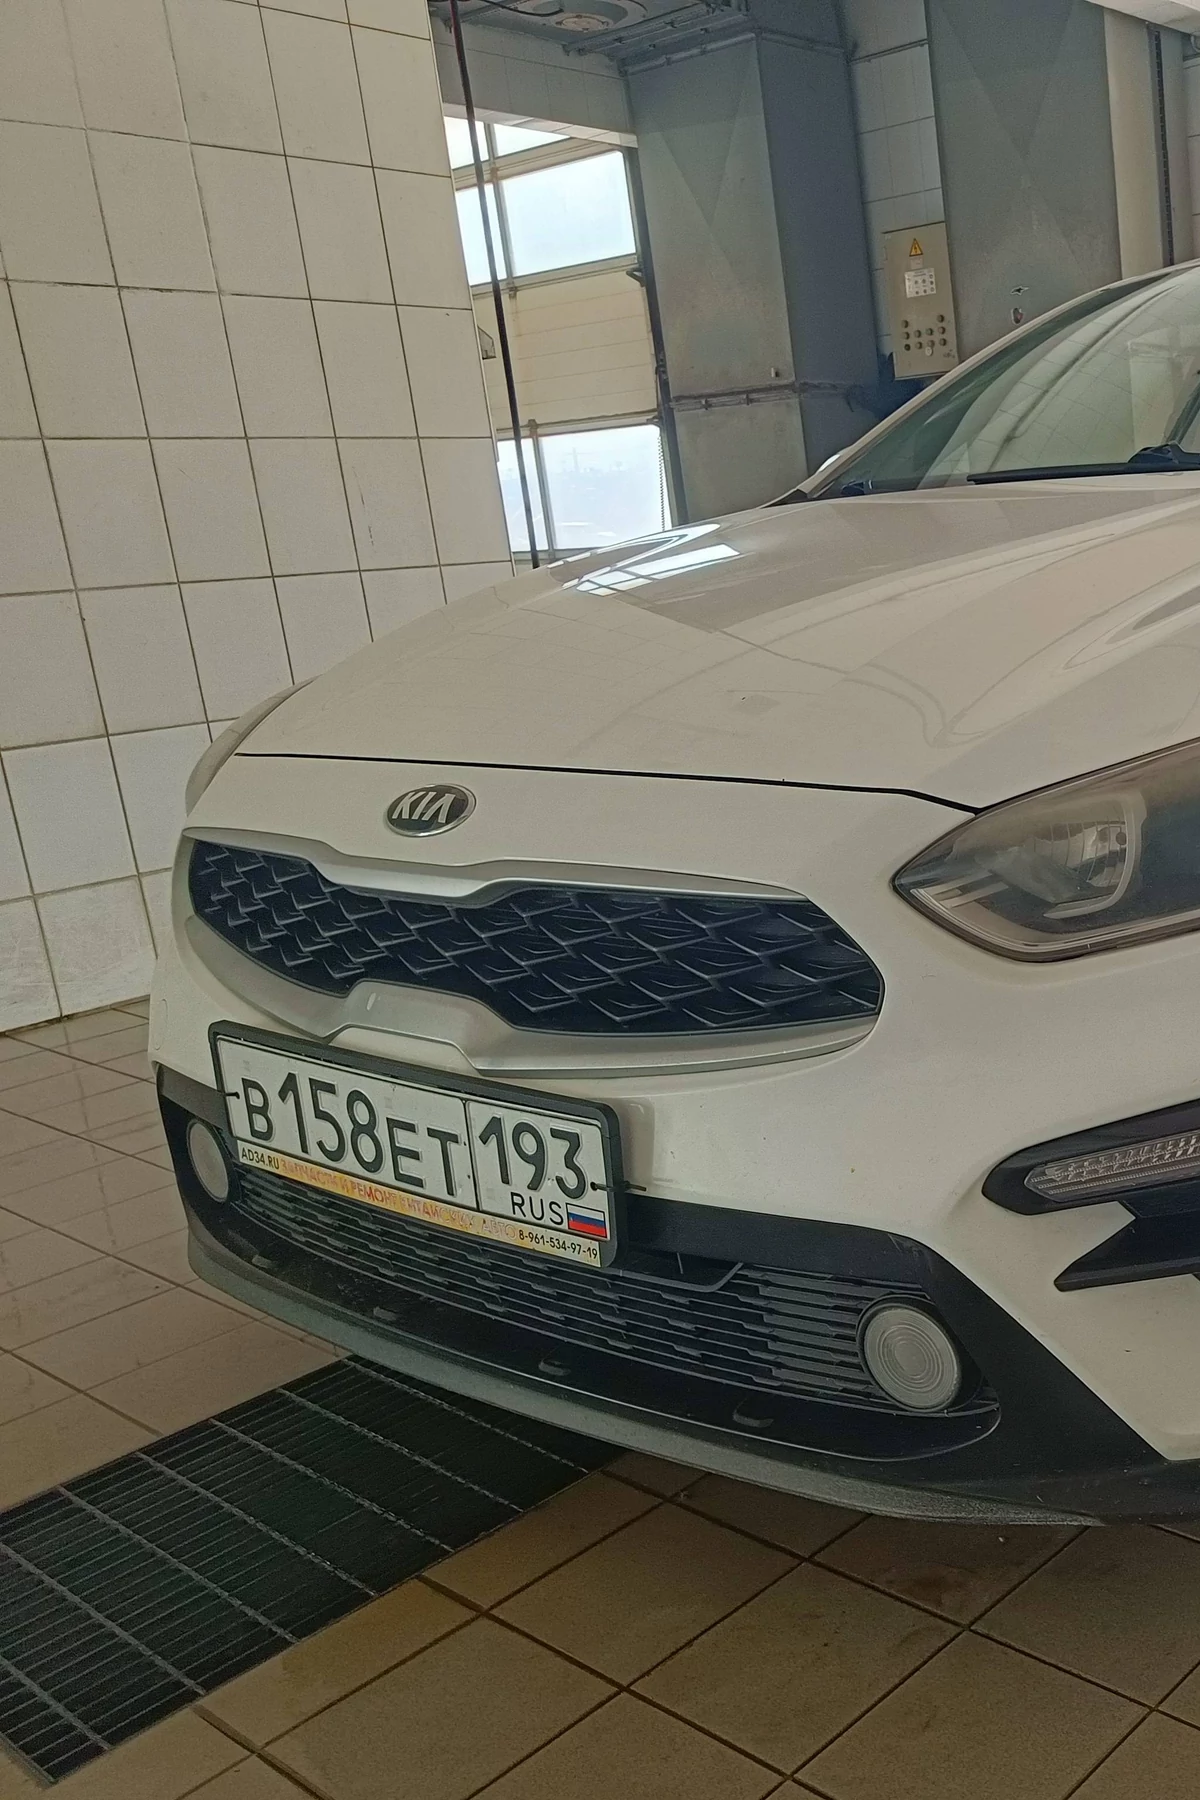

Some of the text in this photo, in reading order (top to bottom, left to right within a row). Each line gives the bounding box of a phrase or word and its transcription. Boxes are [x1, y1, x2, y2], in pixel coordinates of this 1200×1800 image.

[392, 791, 456, 824] KIA
[478, 1116, 587, 1199] 193
[241, 1147, 280, 1170] AD34.RU
[518, 1229, 598, 1260] 8-961-534-97-19
[510, 1191, 564, 1226] RUS
